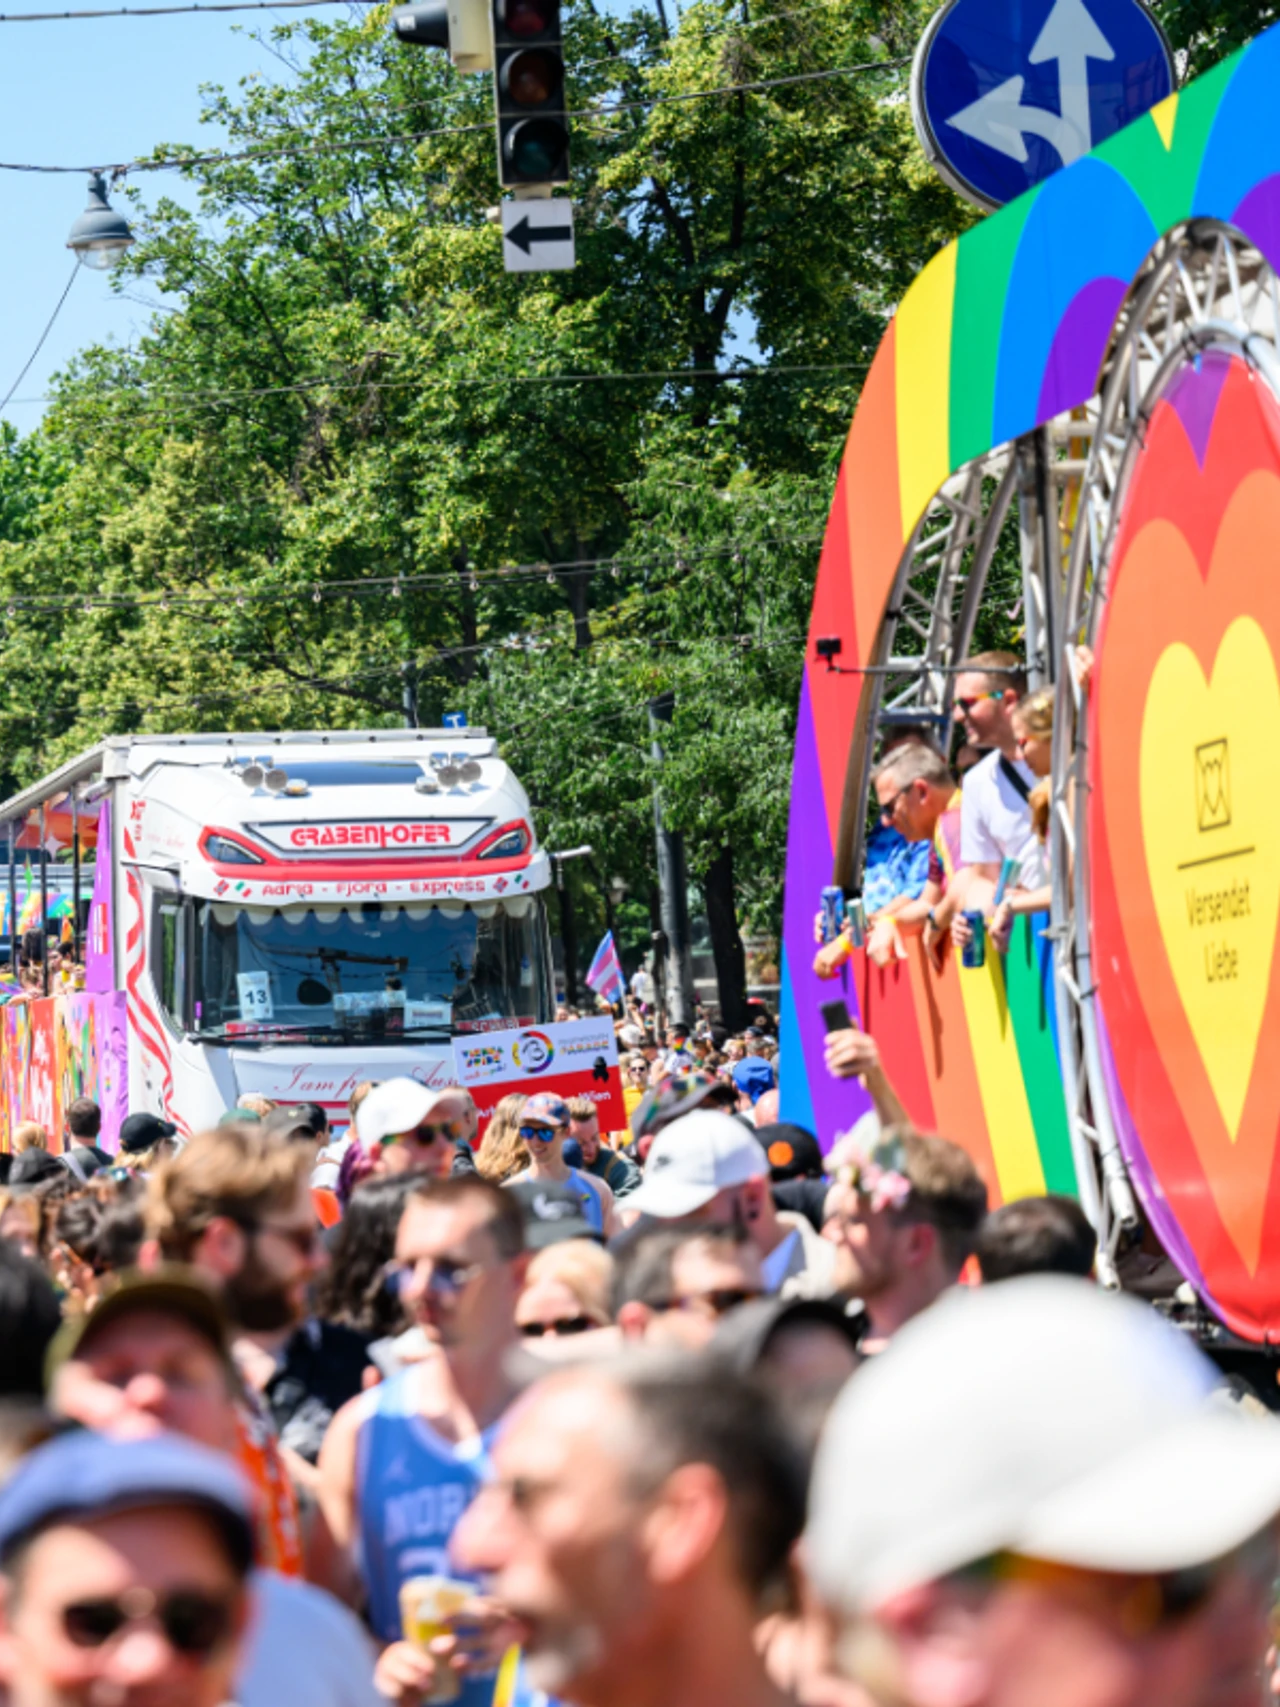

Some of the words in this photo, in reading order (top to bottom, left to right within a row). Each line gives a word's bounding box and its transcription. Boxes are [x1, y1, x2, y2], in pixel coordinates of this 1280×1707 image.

[290, 824, 451, 848] GRABENHOFER
[262, 884, 313, 897] Adria
[409, 879, 486, 896] Express
[1184, 880, 1252, 927] Versendet
[1204, 940, 1239, 984] Liebe
[245, 989, 268, 1004] 13
[300, 1081, 335, 1092] am
